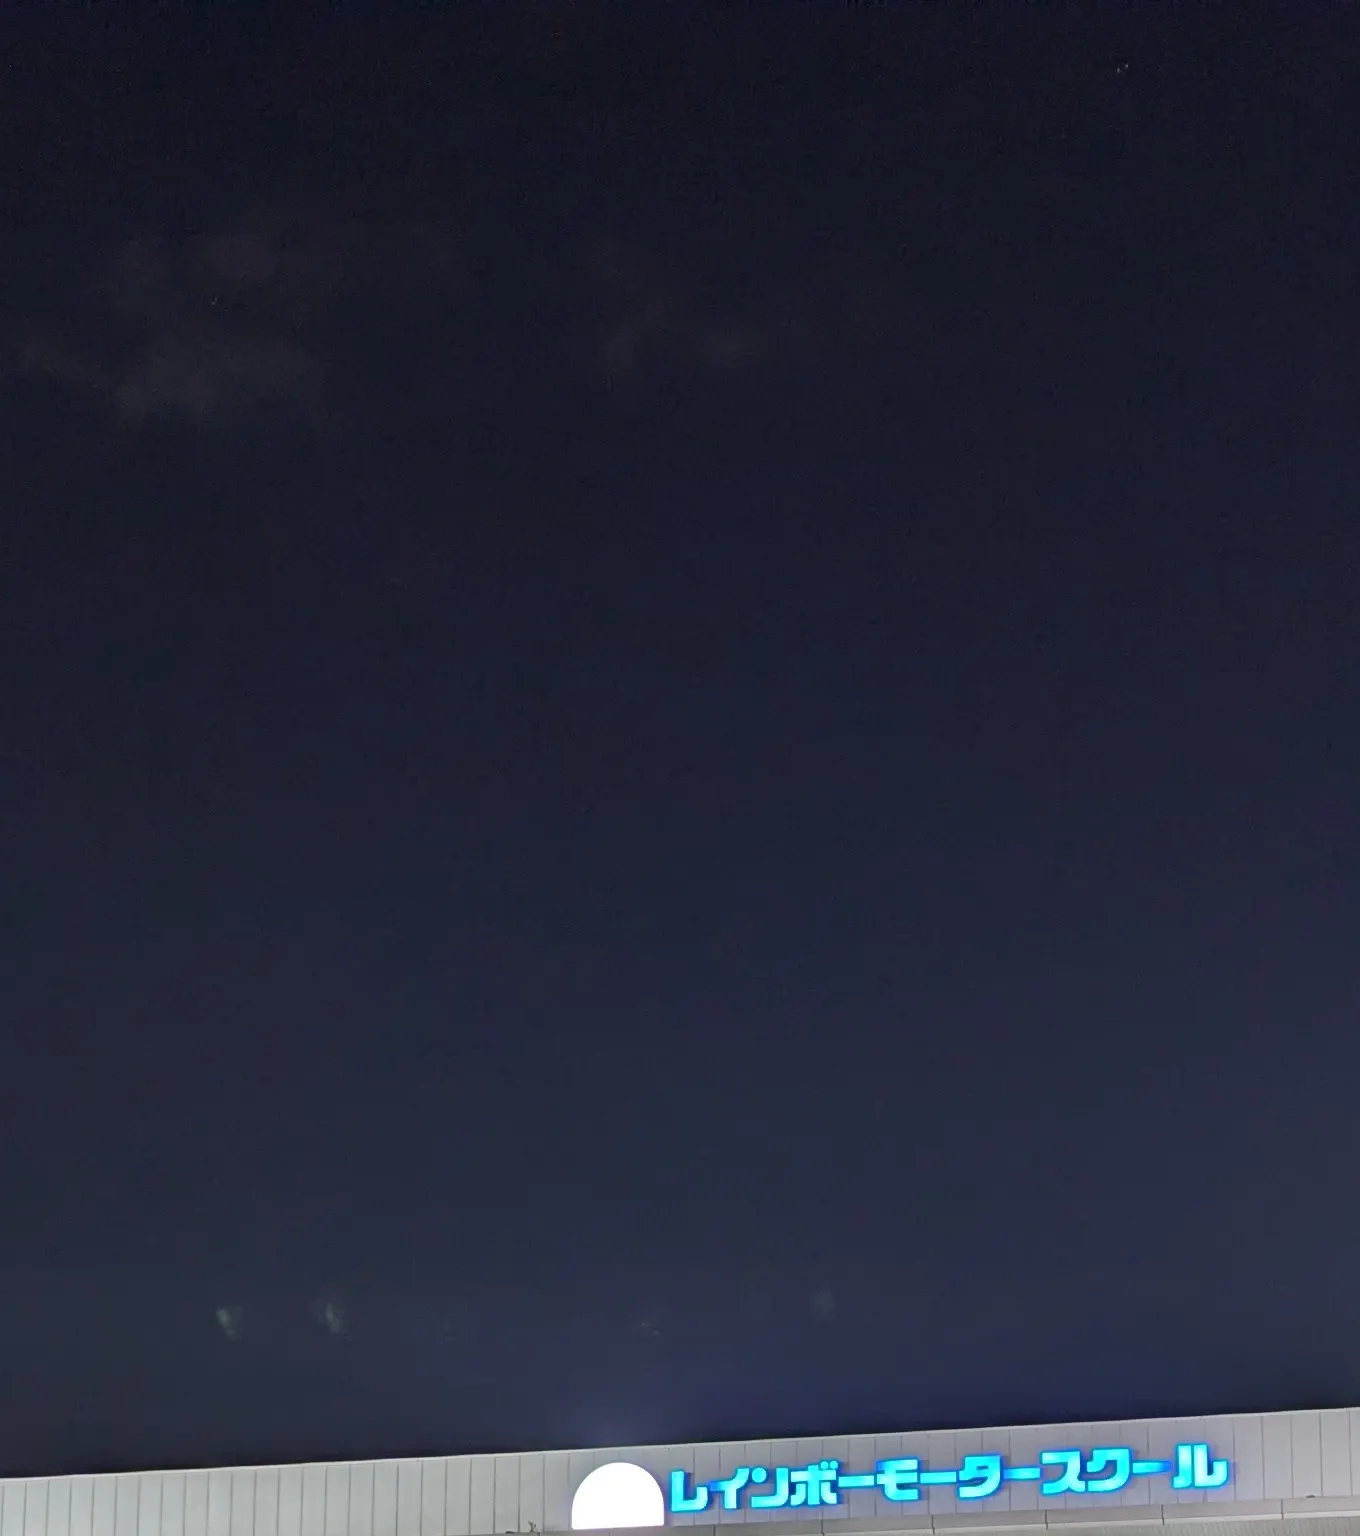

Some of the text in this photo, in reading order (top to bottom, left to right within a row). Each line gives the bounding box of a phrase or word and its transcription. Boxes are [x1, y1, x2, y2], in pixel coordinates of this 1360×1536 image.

[671, 1443, 1228, 1512] レインボーモータースクール
